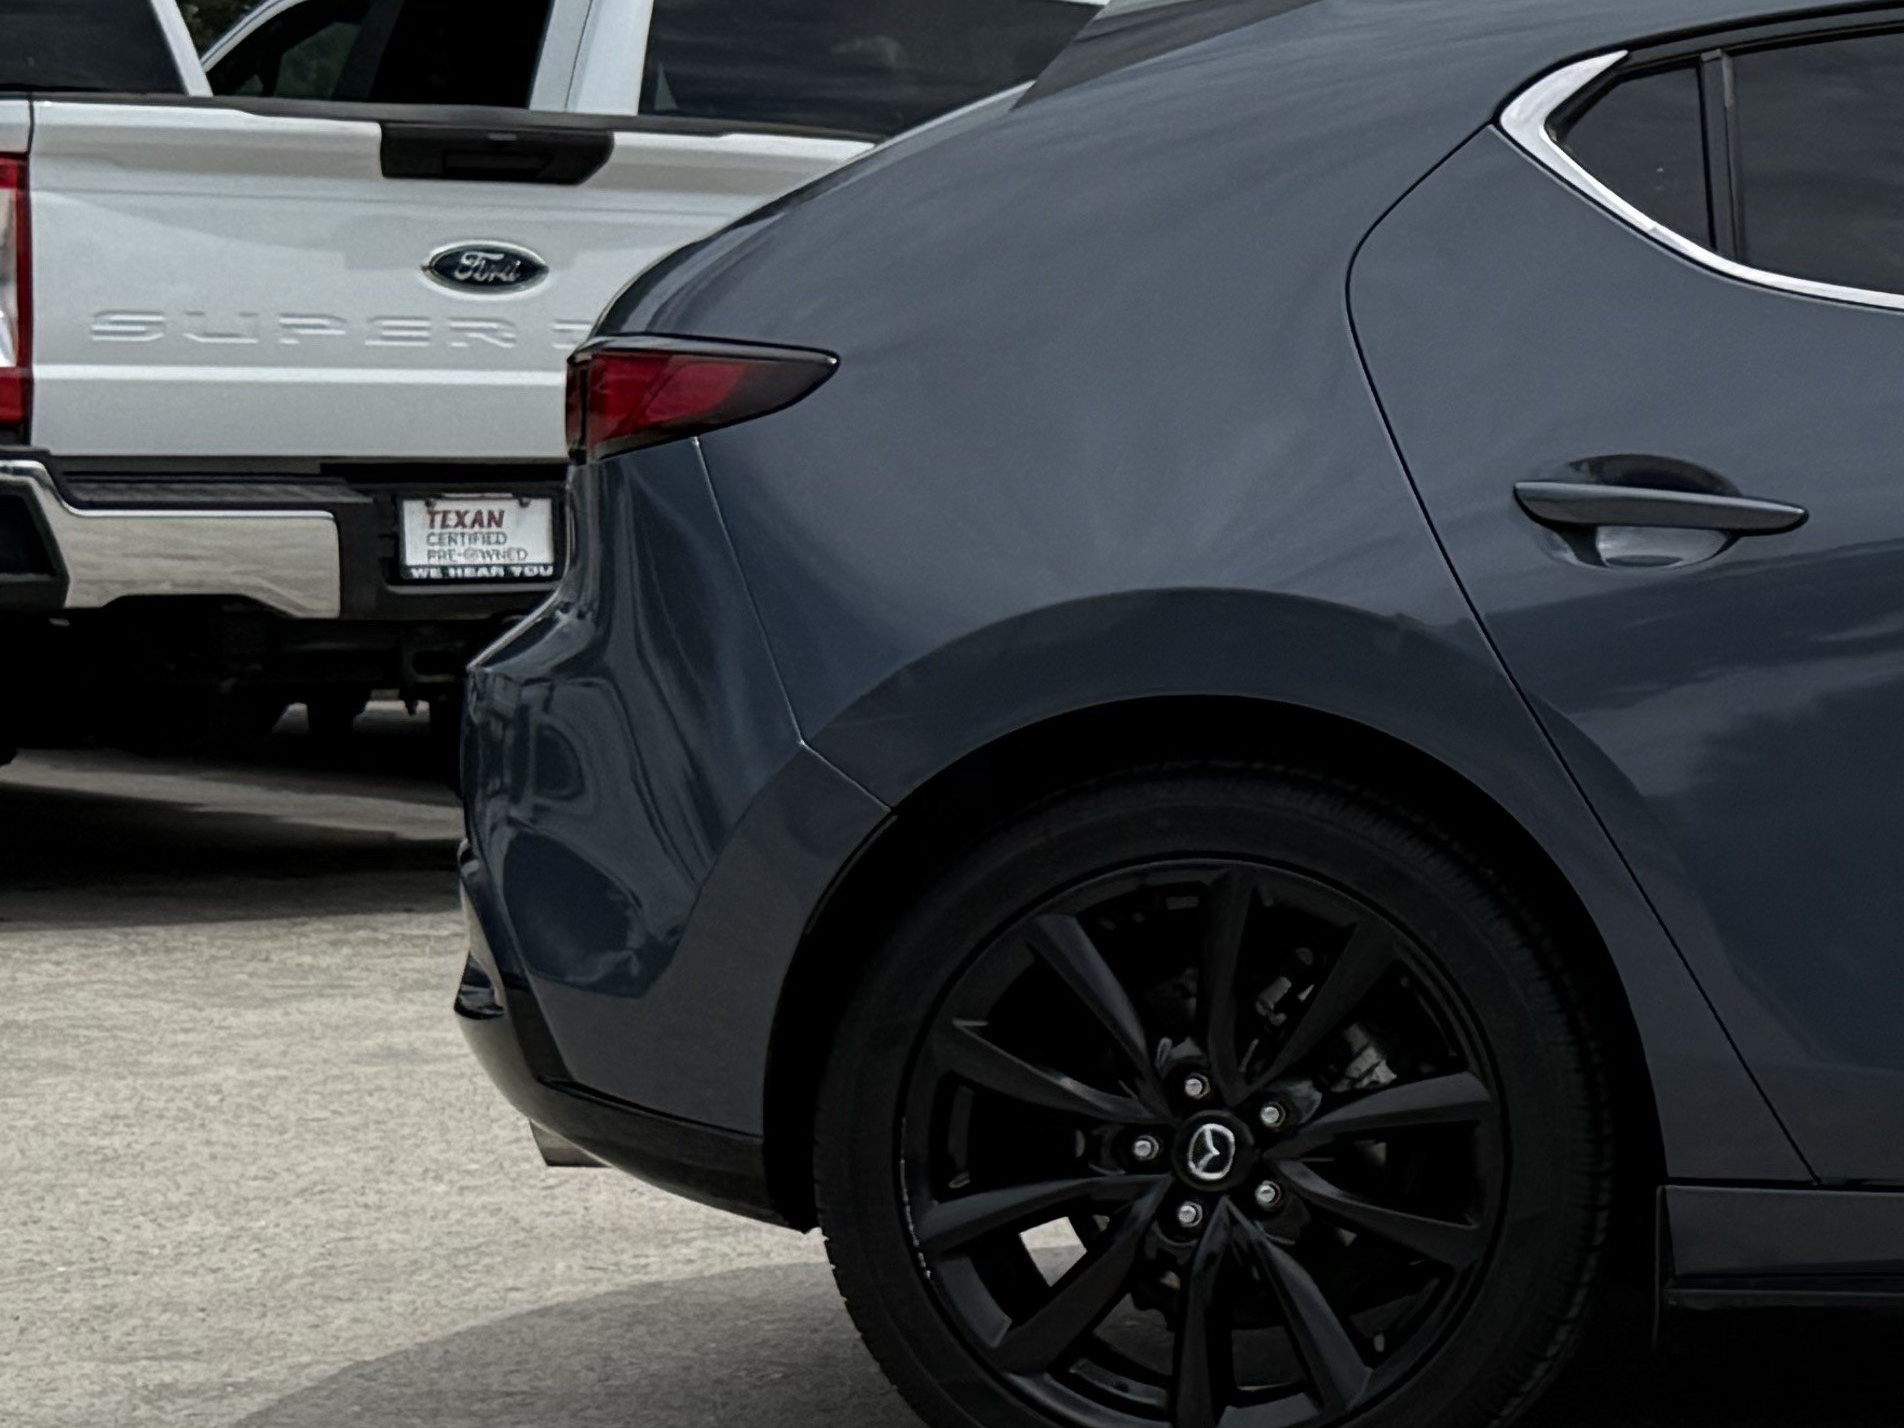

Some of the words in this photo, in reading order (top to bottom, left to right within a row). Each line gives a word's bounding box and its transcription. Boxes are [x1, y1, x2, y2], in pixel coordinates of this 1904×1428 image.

[454, 251, 522, 283] Ford
[91, 309, 516, 349] SUPER
[427, 508, 505, 530] TEXAN
[426, 531, 508, 547] CERTIFIED
[427, 548, 529, 563] PRE-OWNED
[411, 567, 443, 579] WE
[449, 566, 505, 579] HEAR
[510, 565, 554, 578] YOU
